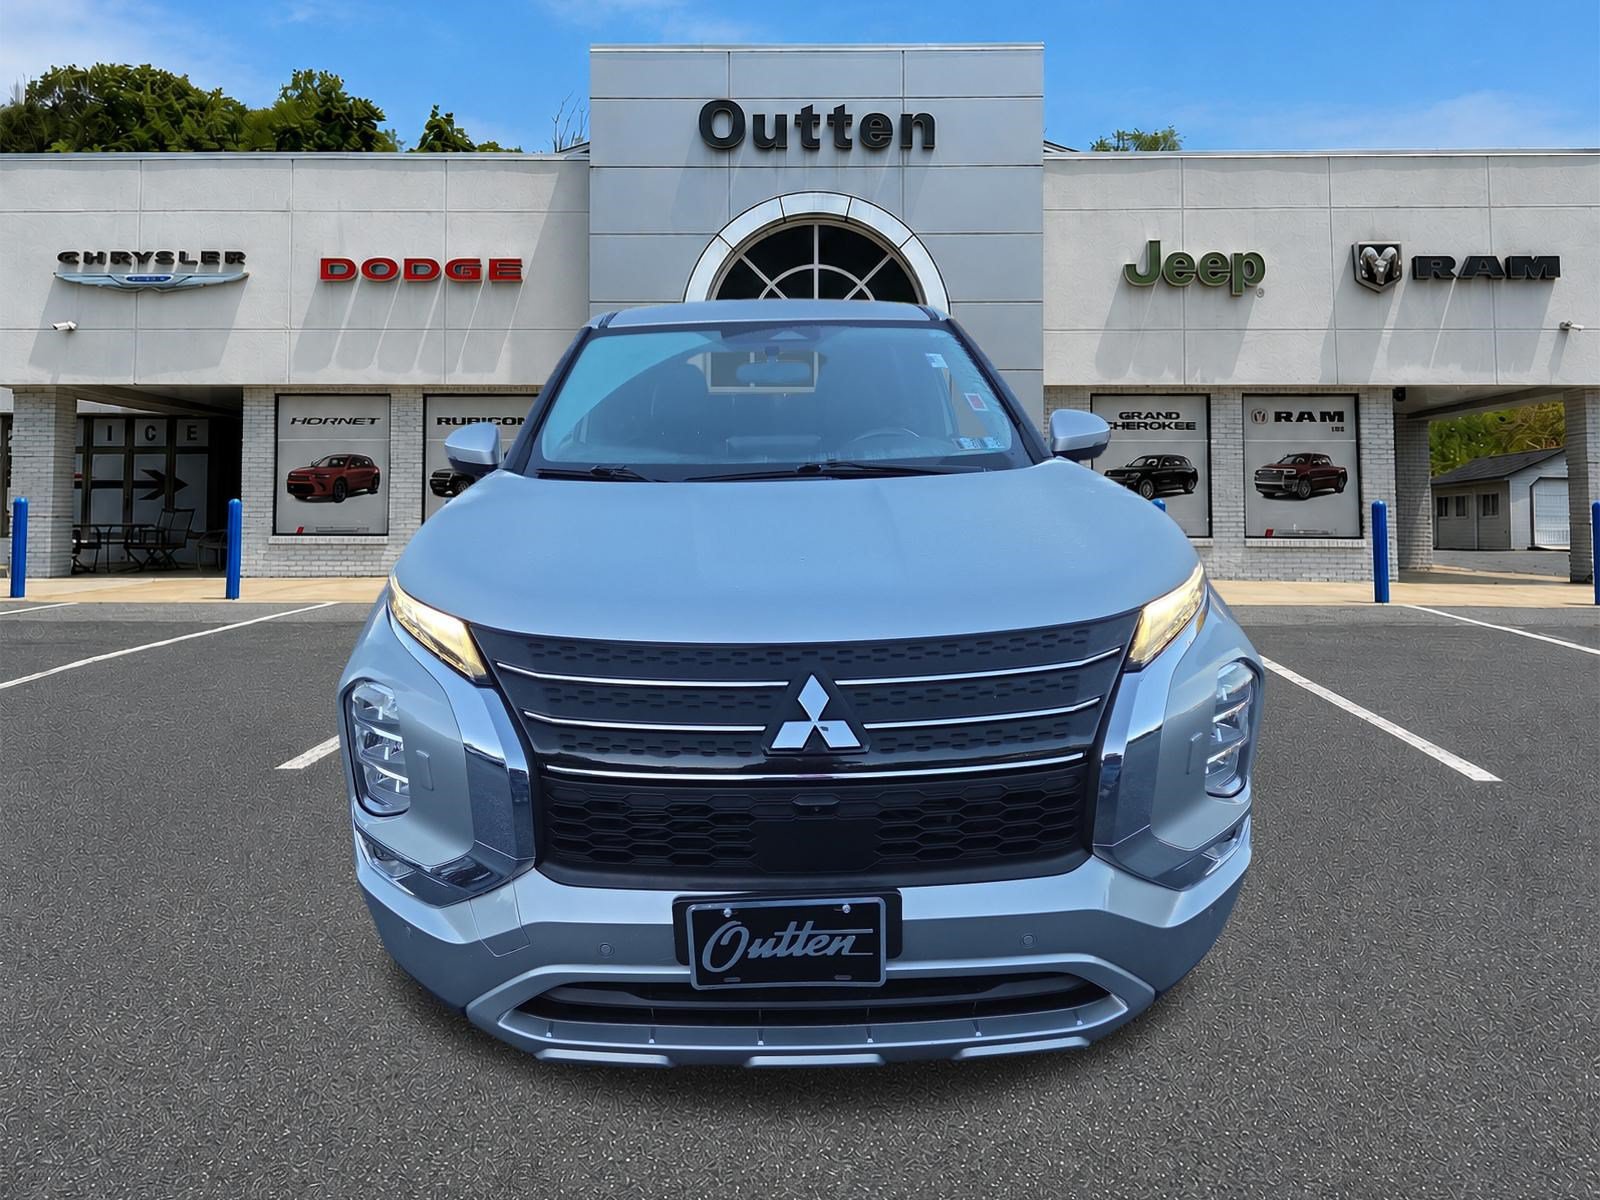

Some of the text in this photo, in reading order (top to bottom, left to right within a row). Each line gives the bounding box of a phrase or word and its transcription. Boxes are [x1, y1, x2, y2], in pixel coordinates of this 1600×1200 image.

[699, 98, 936, 150] Outten
[57, 250, 247, 266] CHRYSLER
[319, 256, 523, 282] DODGE
[1123, 240, 1266, 297] Jeep
[1411, 255, 1561, 280] RAM
[290, 417, 381, 426] HORNET
[1118, 411, 1180, 420] GRAND
[1274, 411, 1344, 423] RAM
[702, 921, 873, 973] Outten
